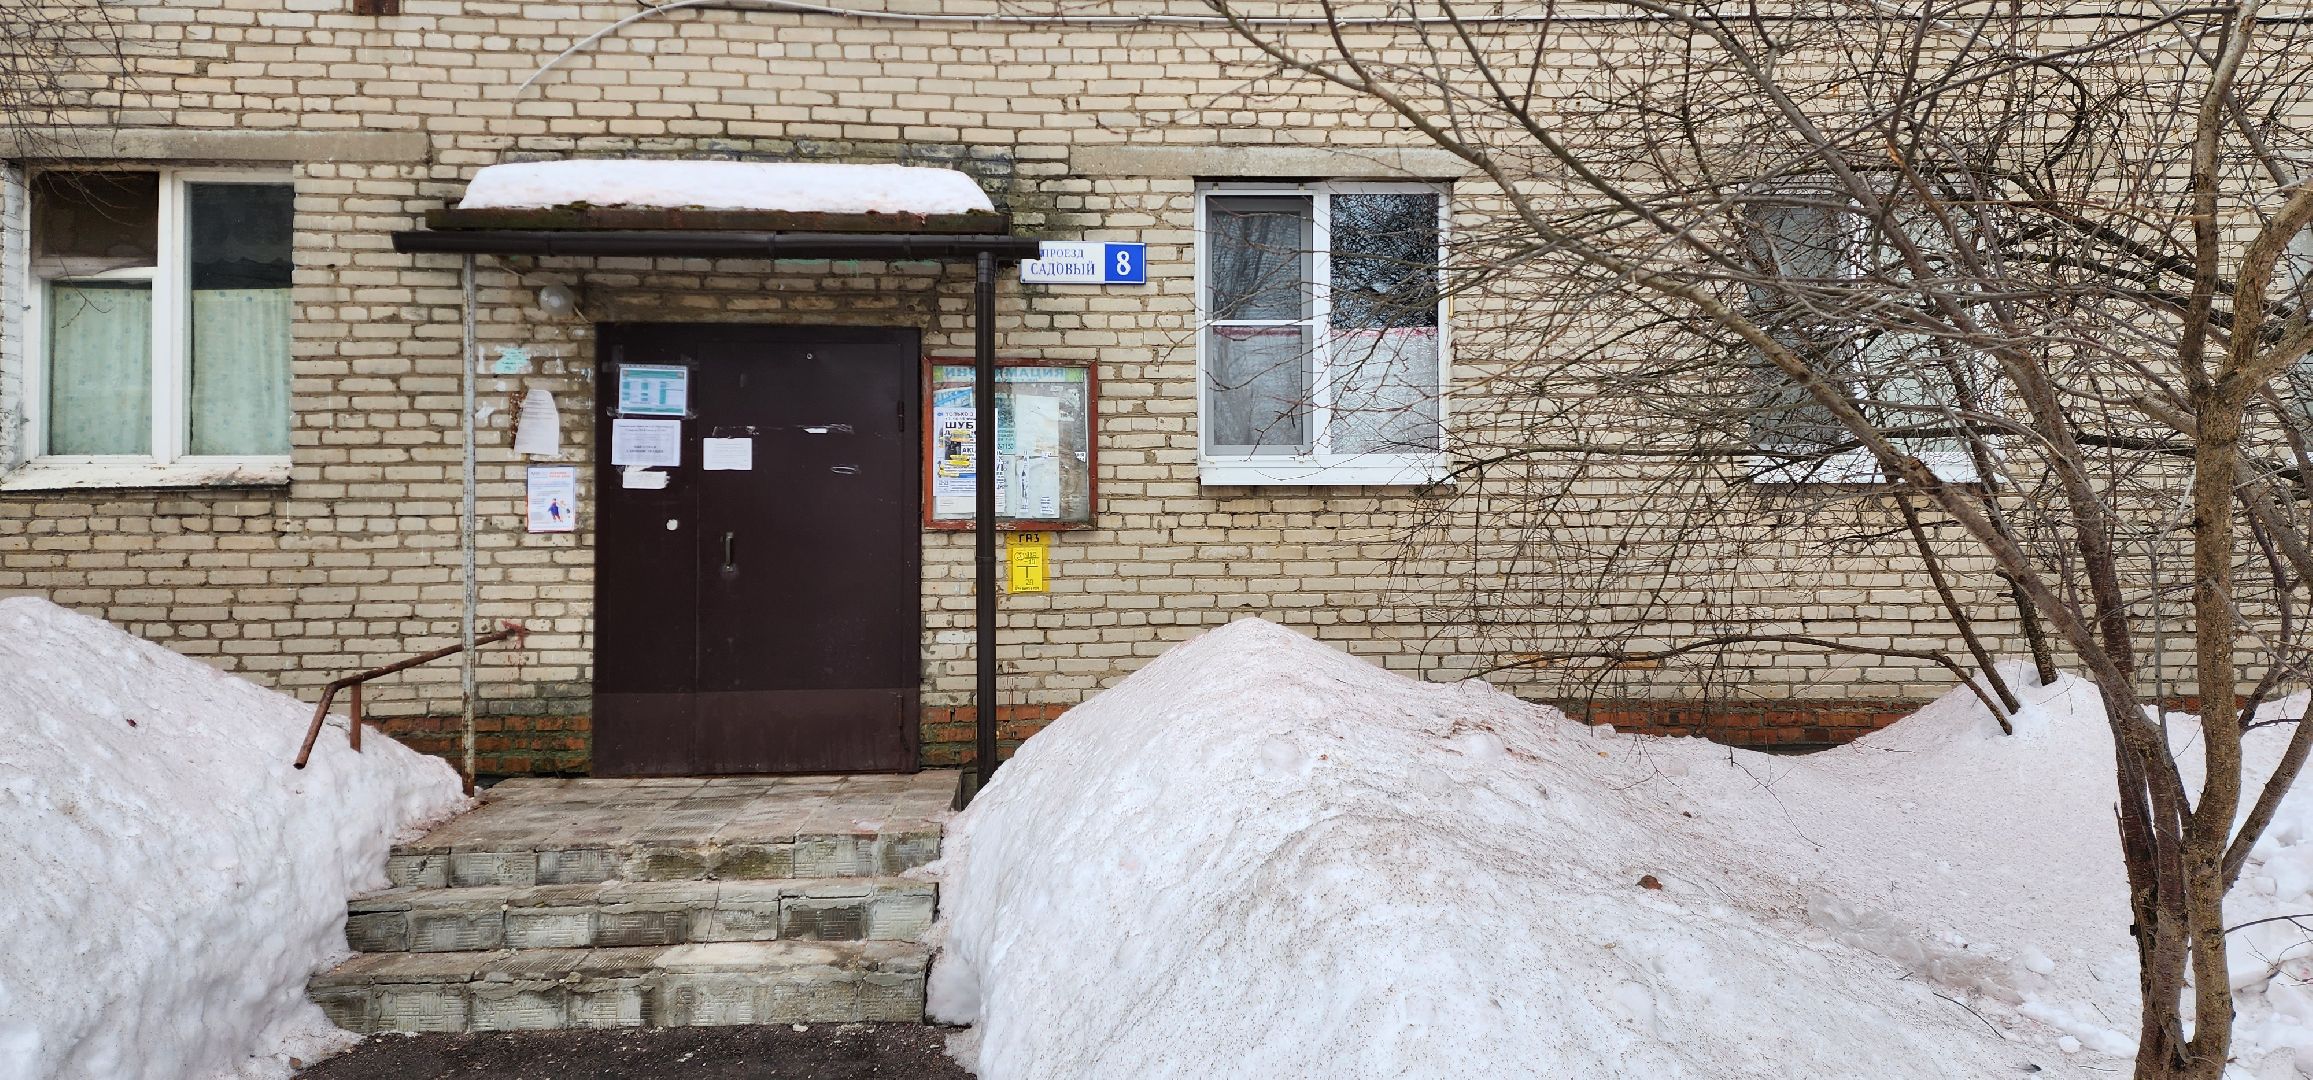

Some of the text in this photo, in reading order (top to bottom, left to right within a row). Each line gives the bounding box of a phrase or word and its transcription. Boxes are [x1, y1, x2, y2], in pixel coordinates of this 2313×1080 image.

[1042, 249, 1084, 259] ПРОЕЗД
[1030, 261, 1095, 276] САДОВЫЙ
[1116, 250, 1131, 276] 8
[945, 367, 1064, 378] ИНРМАЦИЯ
[1018, 533, 1040, 543] ГАЗ
